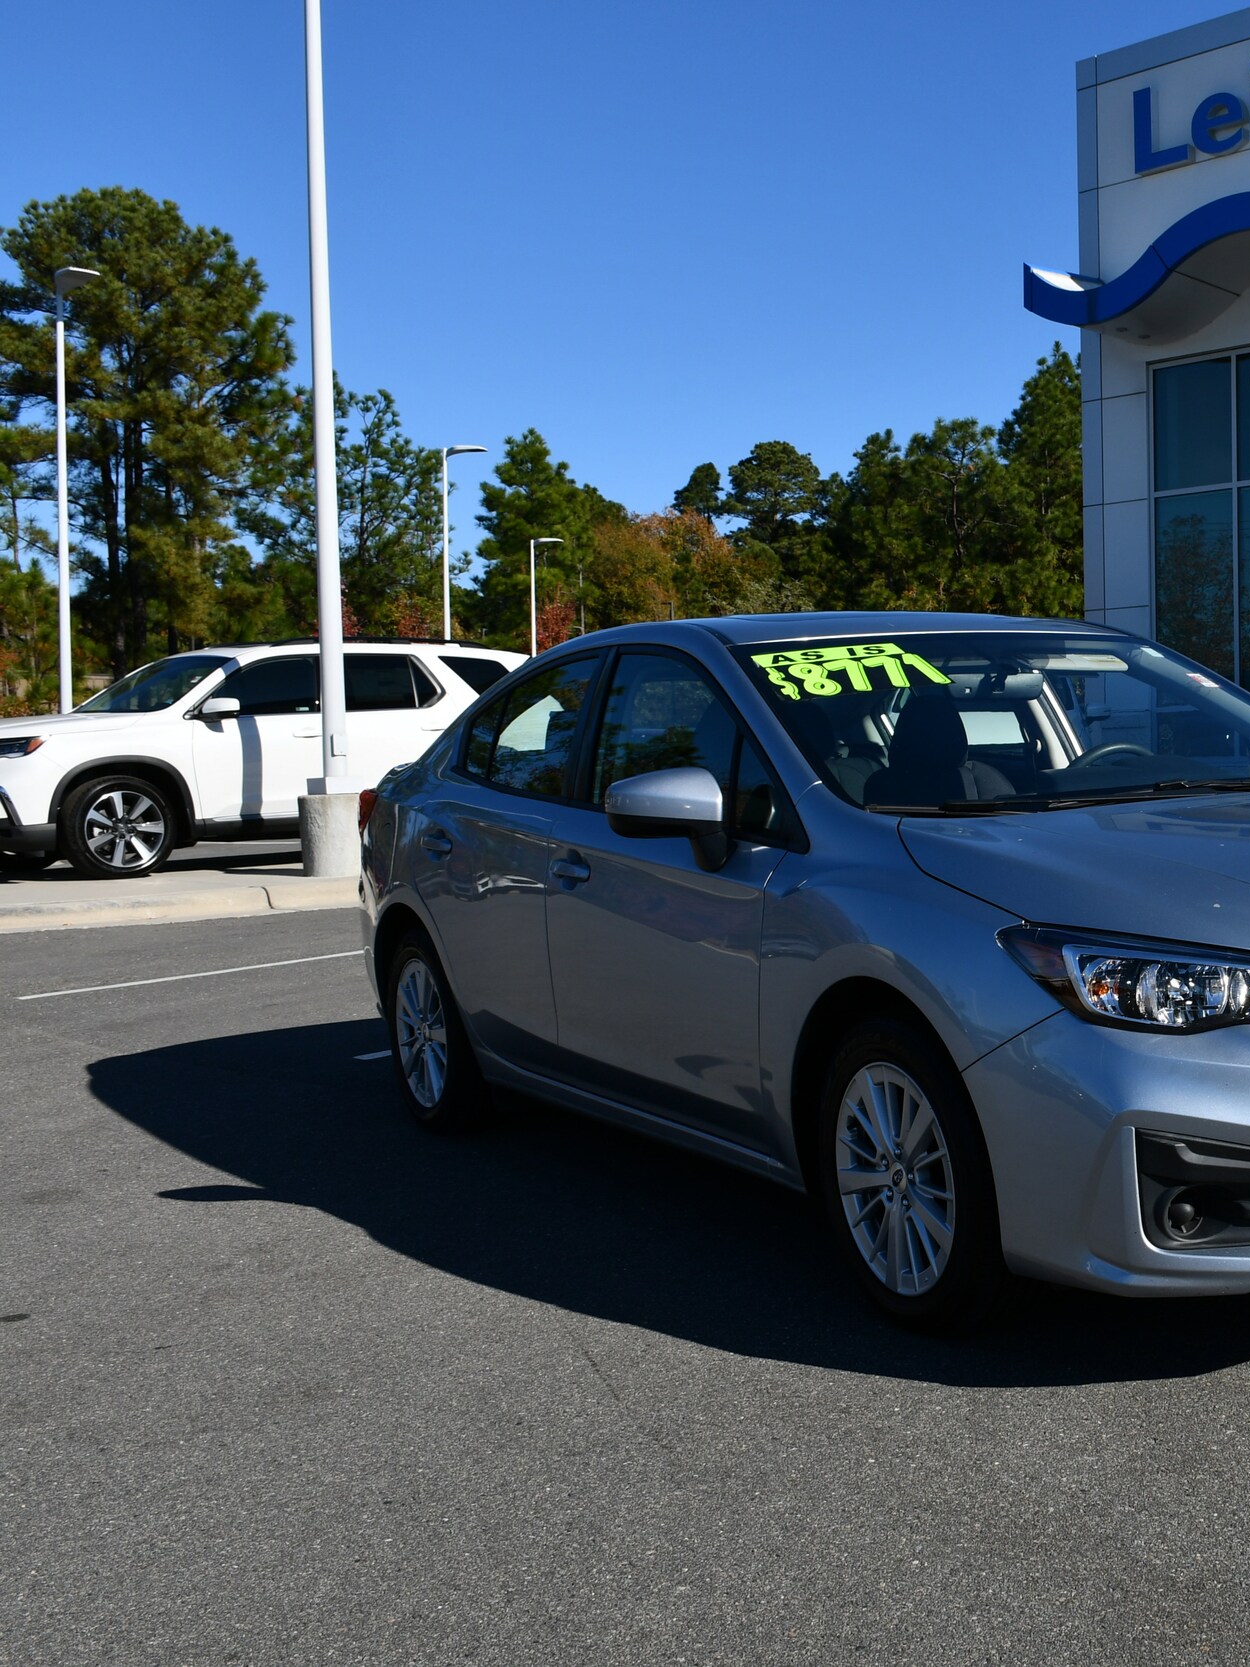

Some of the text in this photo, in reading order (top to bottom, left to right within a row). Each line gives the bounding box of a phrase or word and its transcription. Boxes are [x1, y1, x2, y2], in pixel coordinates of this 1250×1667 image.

[771, 645, 887, 665] AS IS
[765, 652, 954, 701] $8771
